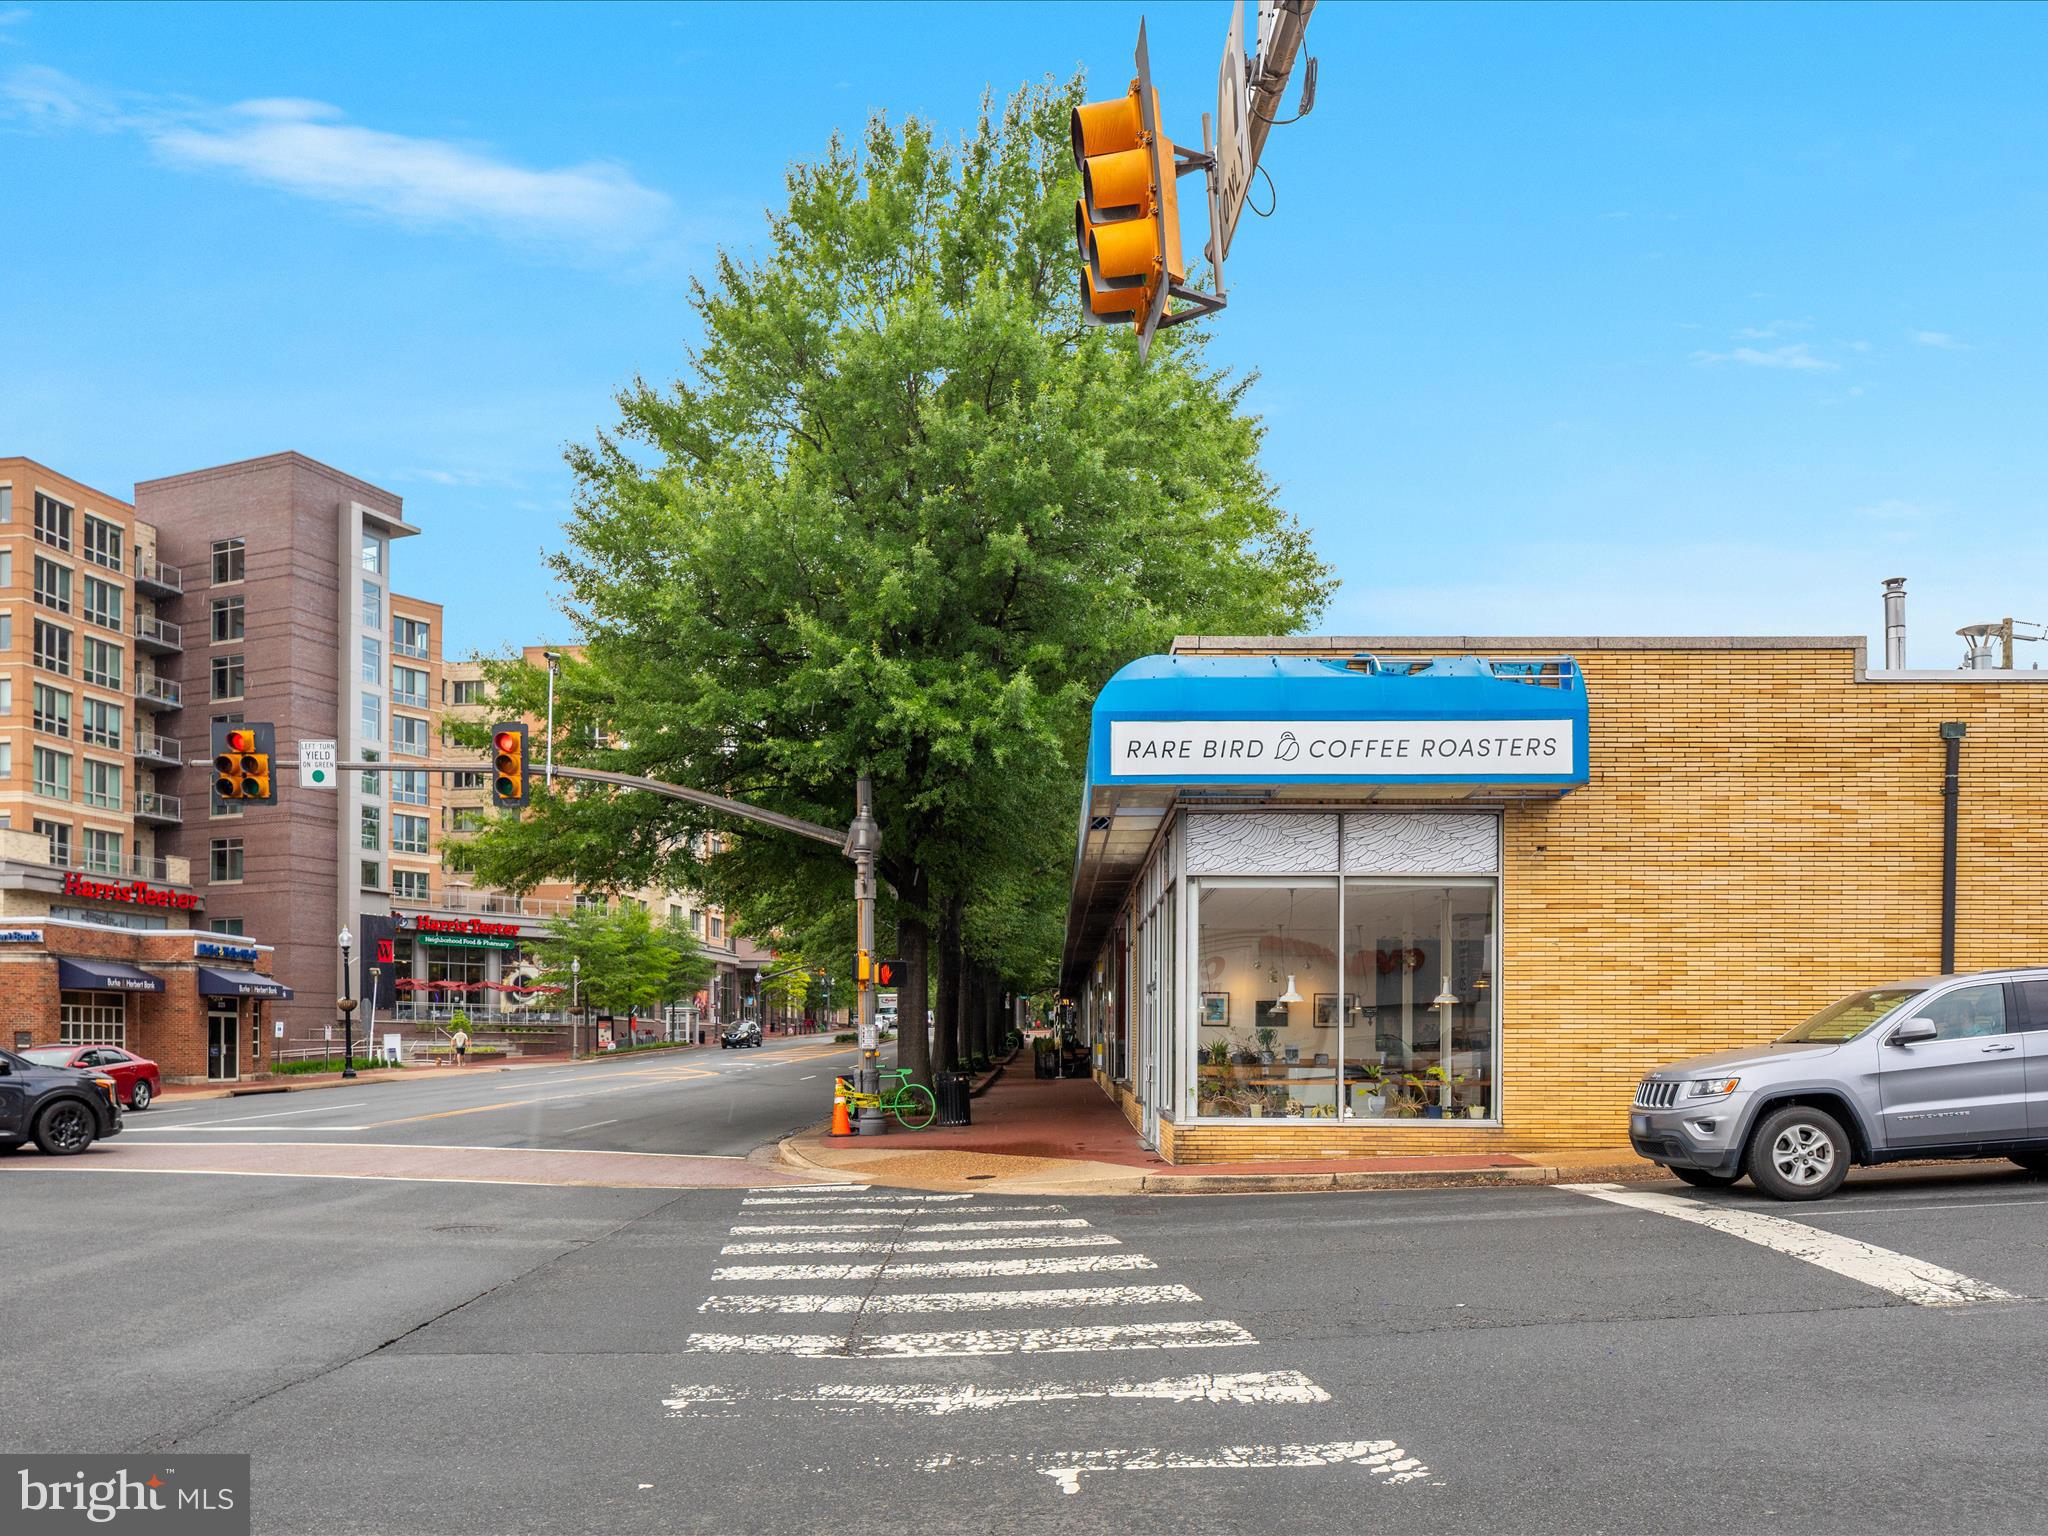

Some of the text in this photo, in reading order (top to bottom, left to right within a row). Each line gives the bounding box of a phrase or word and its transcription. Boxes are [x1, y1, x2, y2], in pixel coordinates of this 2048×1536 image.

[1223, 132, 1245, 225] ONLY
[305, 750, 331, 760] YIELD
[1126, 736, 1558, 760] RARE BIRD COFFEE ROASTERS
[64, 871, 199, 910] Harris Teeter
[416, 914, 521, 938] Harris Teeter
[425, 936, 463, 945] Neighborhood
[483, 940, 510, 949] Pharmacy
[377, 943, 393, 959] W
[107, 977, 121, 987] Burke
[126, 979, 144, 988] Herbert
[143, 980, 155, 989] Bank
[268, 986, 278, 995] Bank
